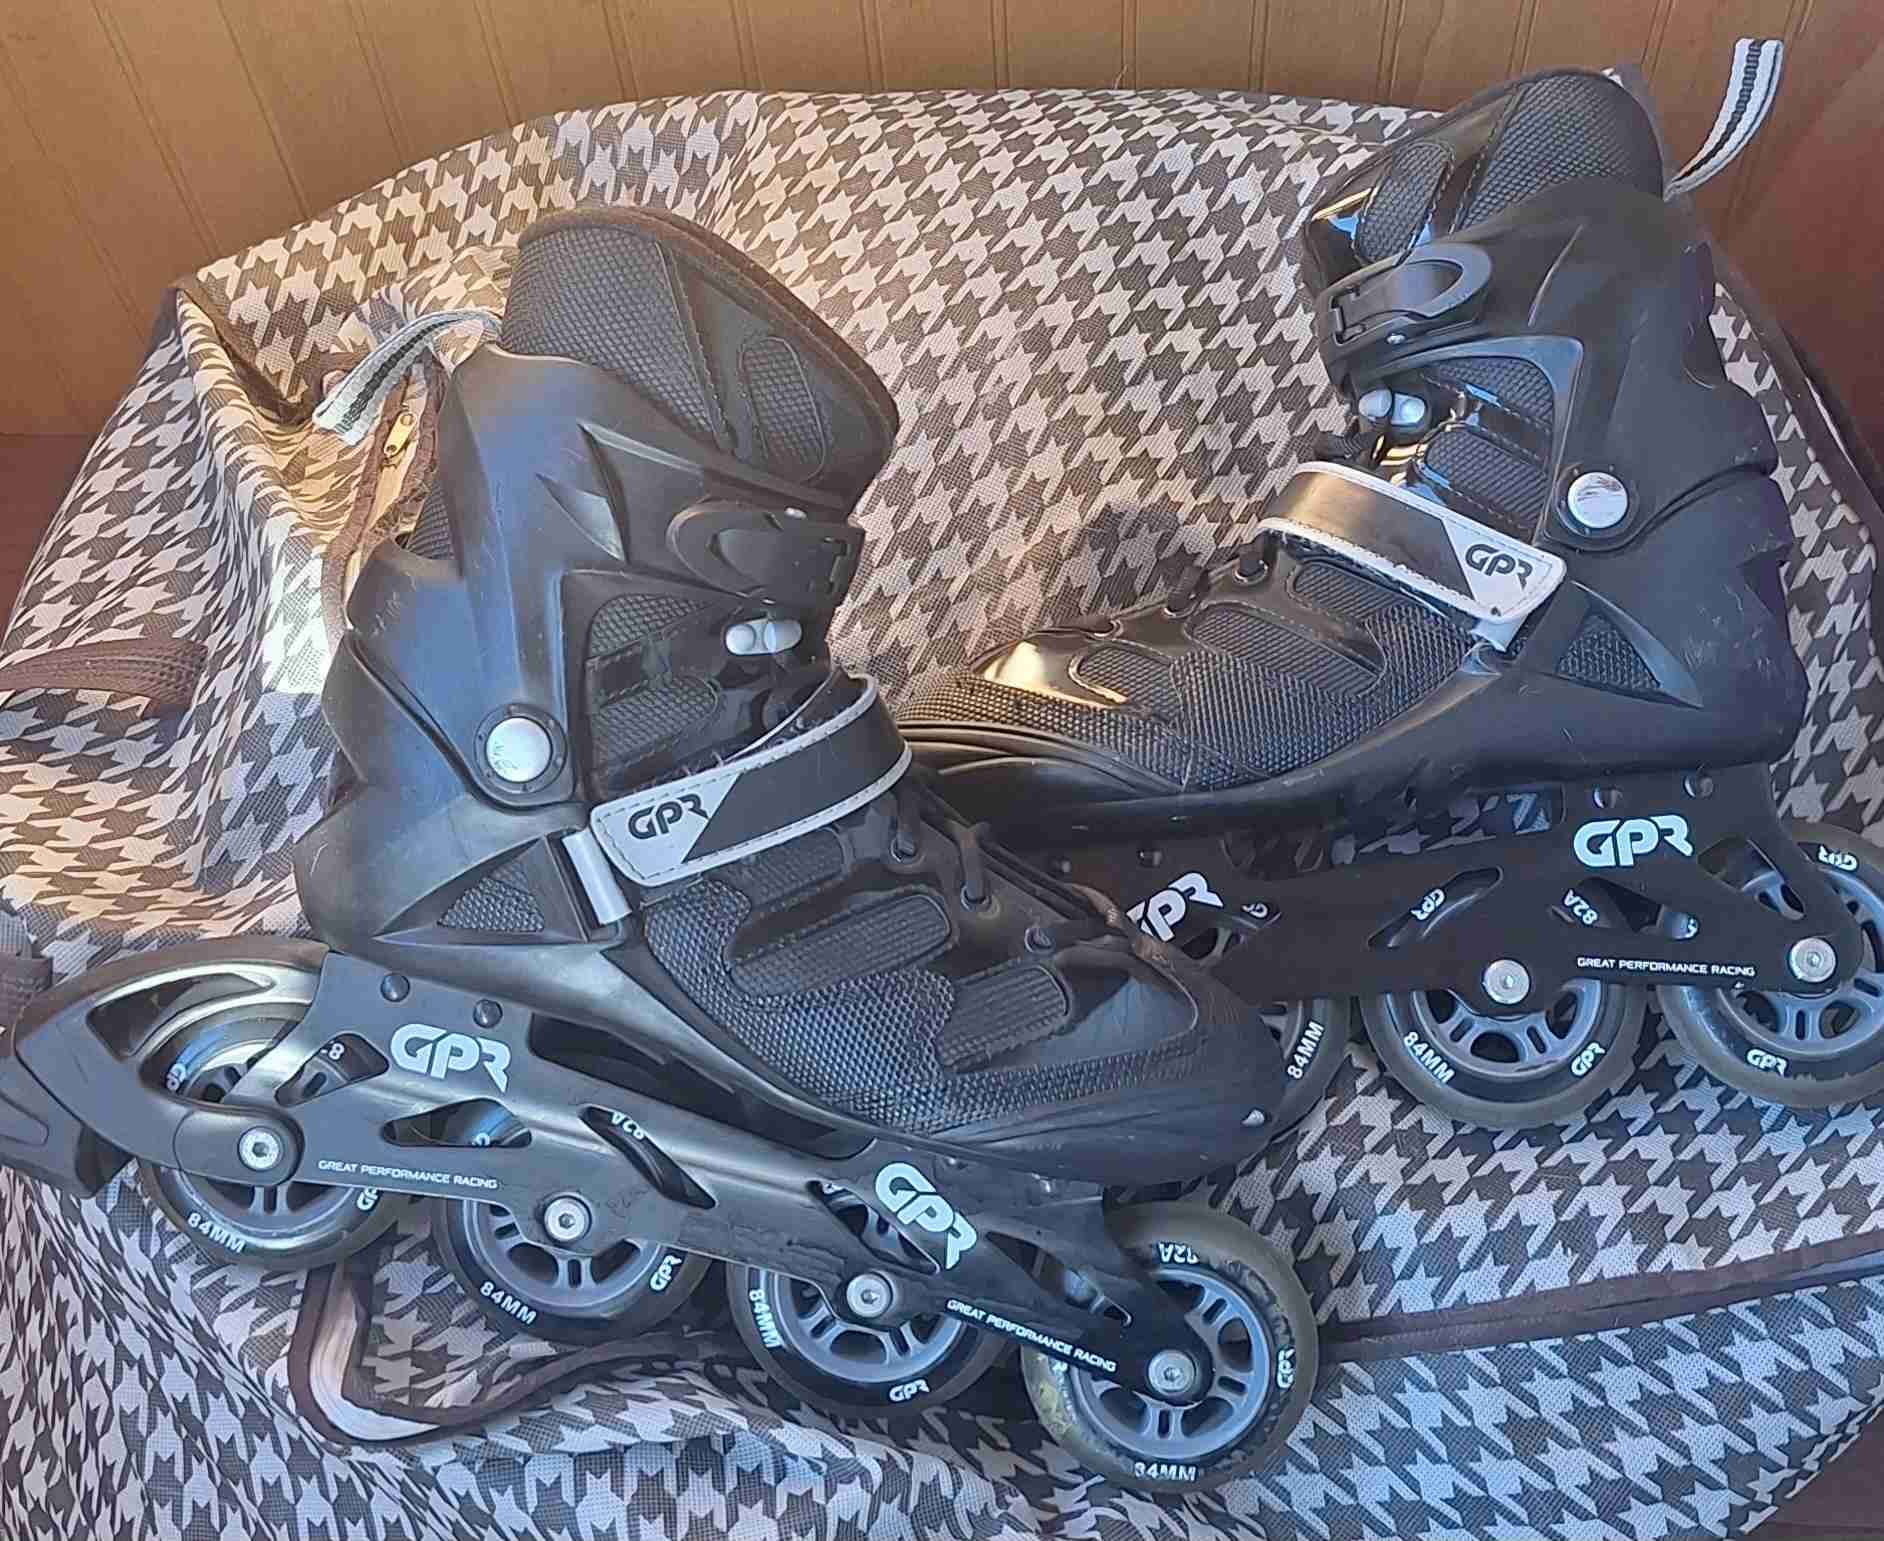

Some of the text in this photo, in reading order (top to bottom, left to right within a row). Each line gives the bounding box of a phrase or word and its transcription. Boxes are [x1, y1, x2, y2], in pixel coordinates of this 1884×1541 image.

[1466, 543, 1534, 591] GPR
[628, 793, 709, 840] GPR
[1573, 814, 1693, 867] GPR
[1410, 888, 1445, 921] GPR
[1564, 889, 1598, 925] 82A
[1577, 957, 1756, 977] GREAT PERFORMANCE RACING
[391, 1023, 511, 1094] GPR
[1287, 1020, 1325, 1080] 84MM
[1403, 1031, 1456, 1084] 84MM
[1570, 1042, 1606, 1077] GPR
[1746, 1048, 1788, 1077] GPR
[318, 1160, 498, 1189] GREAT PERFORMANCE RACING
[356, 1186, 379, 1212] GP
[875, 1162, 978, 1270] GPR
[187, 1212, 246, 1254] 84MM
[649, 1255, 683, 1291] GPR
[480, 1281, 538, 1325] 84MM
[749, 1288, 783, 1348] 84MM
[946, 1299, 987, 1322] GREAT
[986, 1313, 1074, 1355] PERFORMANCE
[1073, 1348, 1117, 1373] RACING
[889, 1379, 931, 1403] GPR
